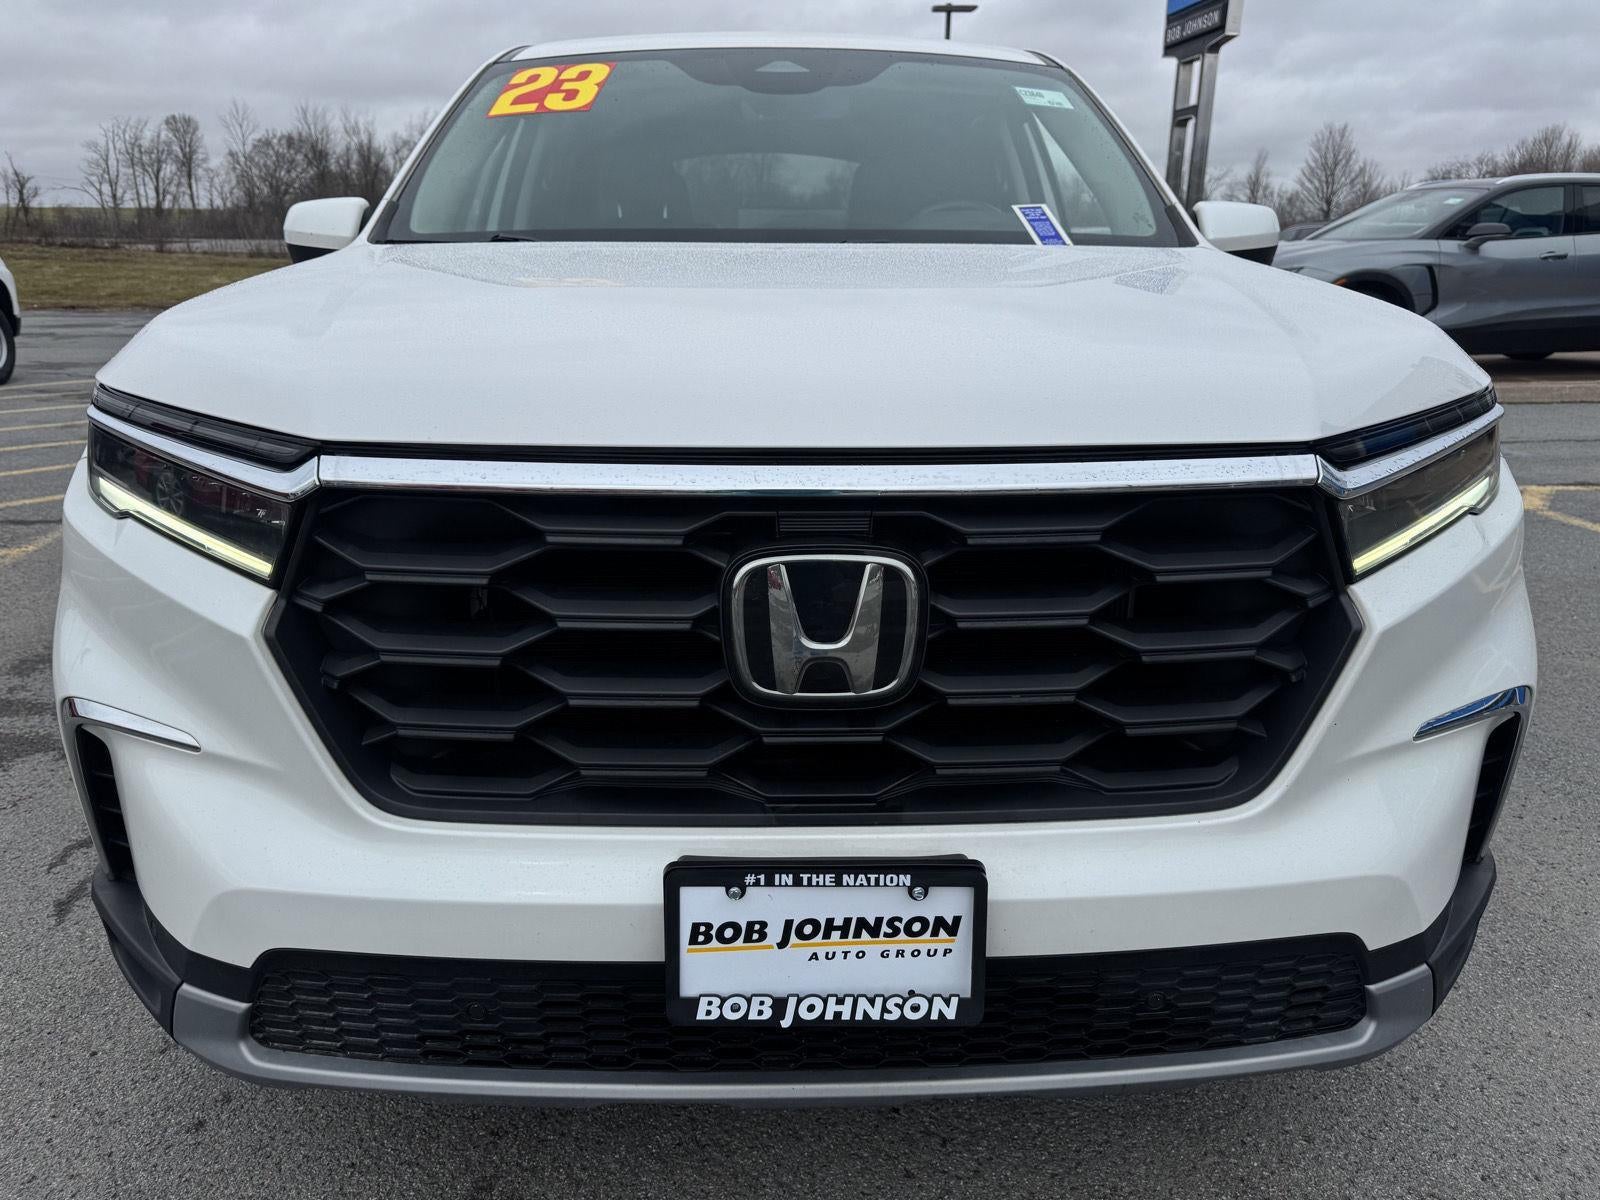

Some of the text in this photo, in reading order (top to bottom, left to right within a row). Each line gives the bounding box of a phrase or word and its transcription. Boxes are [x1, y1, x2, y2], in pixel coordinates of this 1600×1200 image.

[1166, 10, 1220, 43] BOB JOHNSON
[487, 63, 611, 116] 23
[744, 873, 911, 887] #1 IN THE NATION
[688, 915, 962, 950] BOB JOHNSON
[807, 948, 953, 962] AUTO GROUP
[696, 996, 959, 1029] BOB JOHNSON
